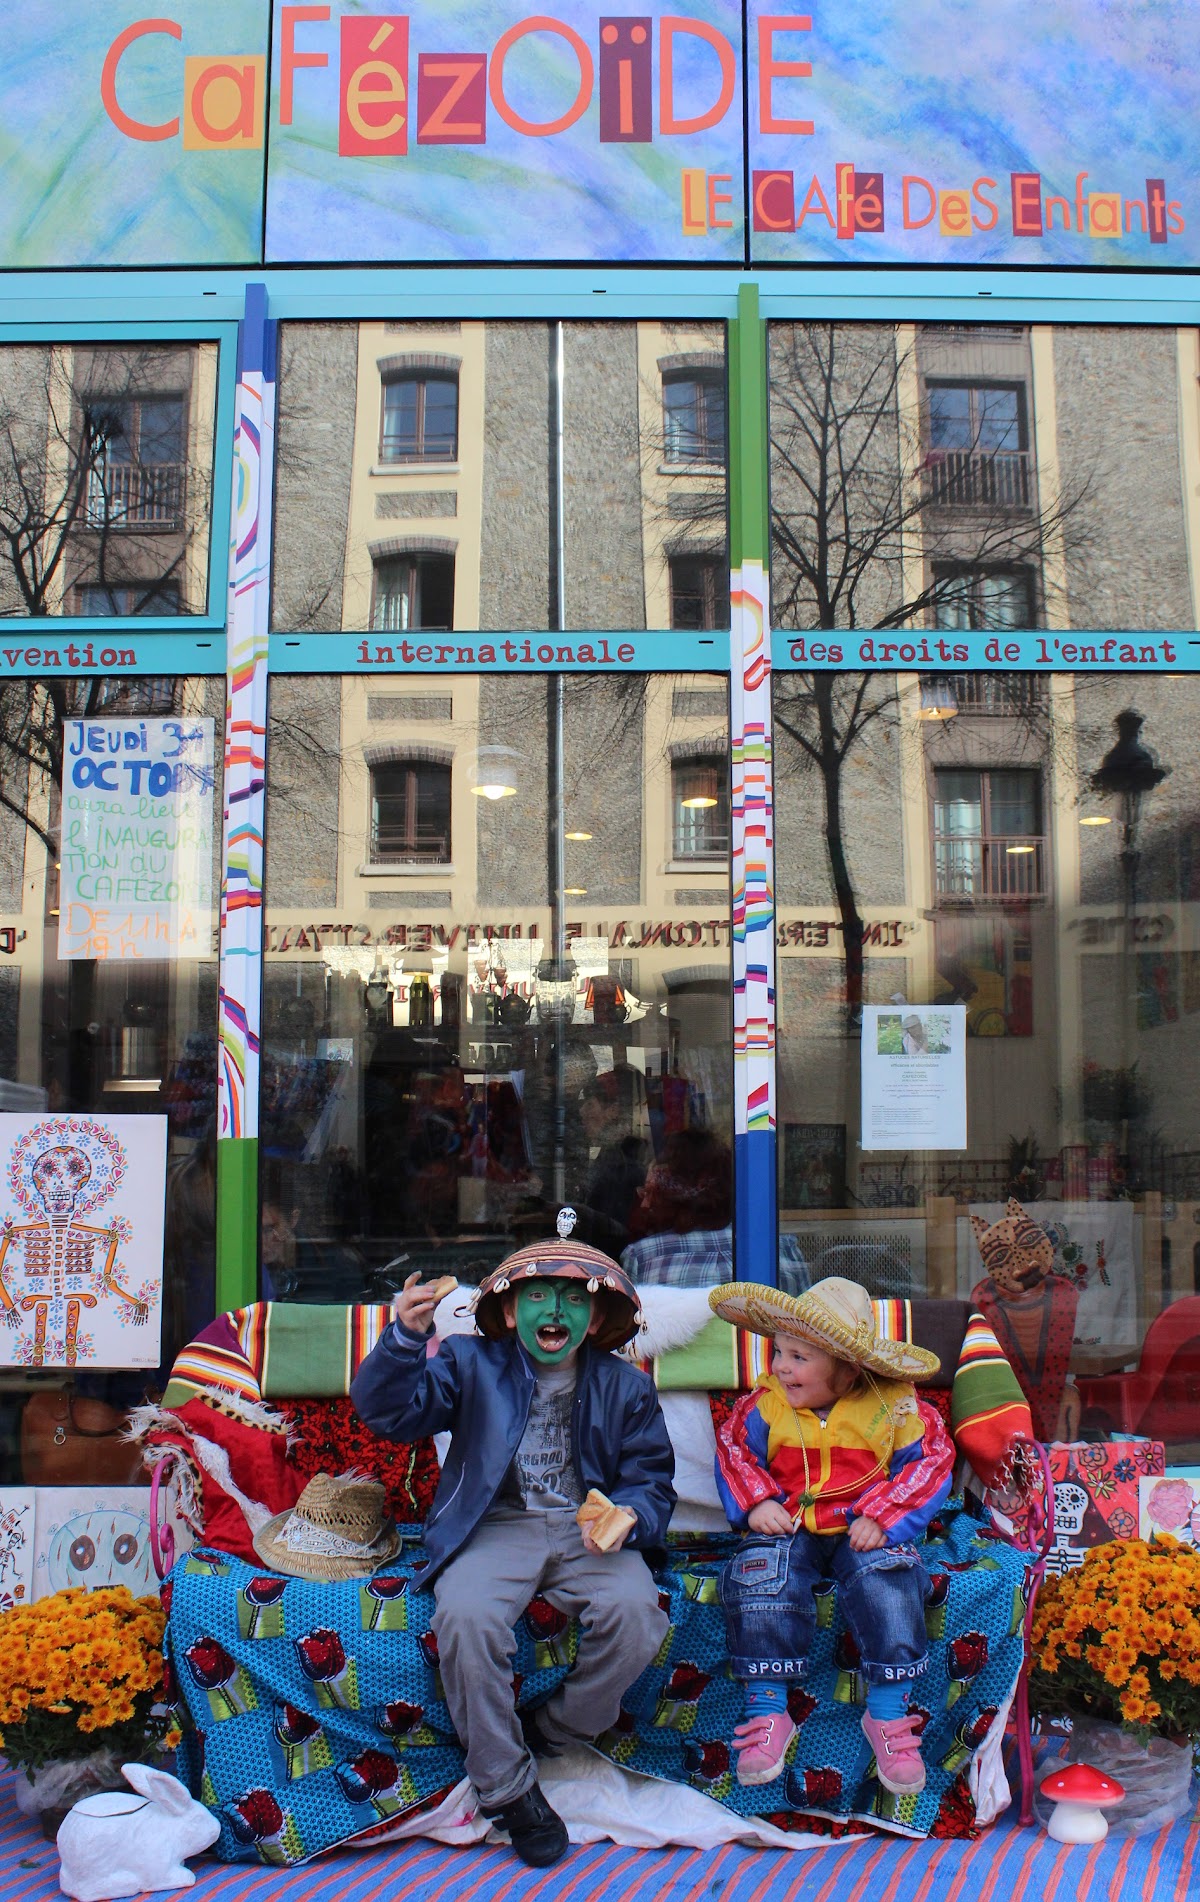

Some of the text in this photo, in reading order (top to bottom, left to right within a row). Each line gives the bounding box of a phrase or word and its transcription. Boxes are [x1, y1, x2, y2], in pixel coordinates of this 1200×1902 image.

[684, 165, 1184, 234] LE CAfé DeS Enfants
[0, 639, 1177, 668] vention internationale des droits de l'enfant
[72, 757, 214, 798] OCTOB
[68, 796, 125, 815] aura
[65, 902, 110, 935] DE
[748, 1660, 804, 1675] SPORT
